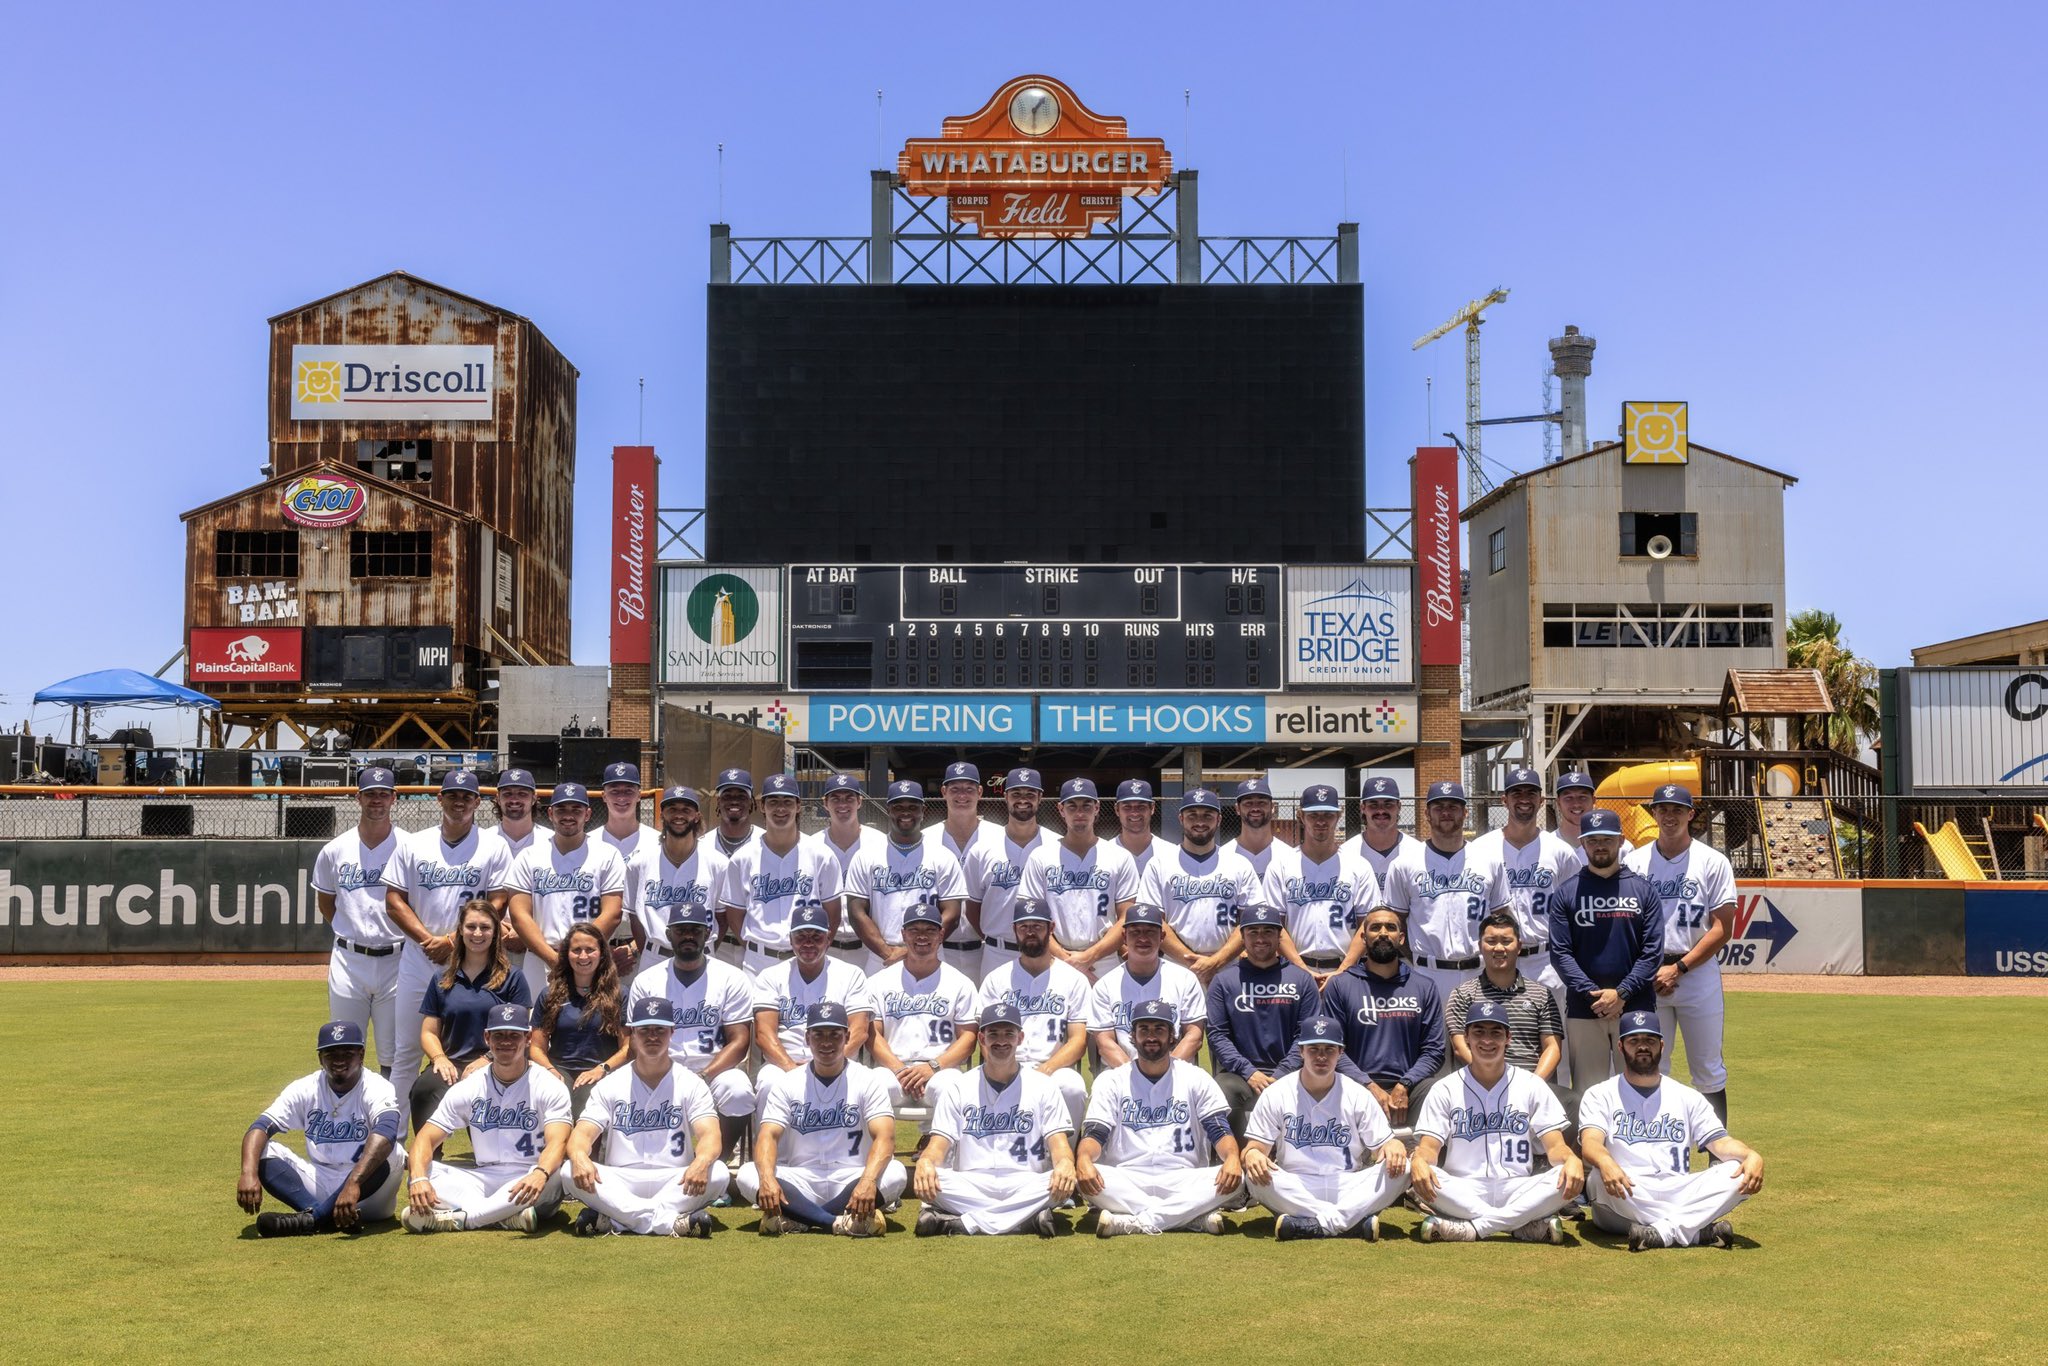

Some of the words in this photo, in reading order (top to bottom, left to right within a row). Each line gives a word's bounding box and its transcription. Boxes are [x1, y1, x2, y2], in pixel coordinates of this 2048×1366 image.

[921, 151, 1149, 174] WHATABURGER
[957, 196, 989, 205] CORPUS
[1080, 196, 1113, 205] CHRISTI
[999, 193, 1070, 224] Field
[344, 363, 486, 393] Driscoll
[618, 483, 645, 625] Budweiser
[1426, 484, 1454, 627] Budweiser
[807, 568, 825, 583] AT
[830, 568, 857, 583] BAT
[929, 568, 967, 583] BALL
[1025, 568, 1079, 583] STRIKE
[1134, 568, 1165, 583] OUT
[1231, 568, 1257, 584] H/E
[239, 599, 299, 623] BAM
[1304, 612, 1395, 637] TEXAS
[888, 624, 895, 636] 1
[908, 624, 916, 636] 2
[930, 624, 938, 636] 3
[954, 624, 962, 636] 4
[975, 624, 982, 636] 5
[996, 624, 1003, 636] 6
[1021, 624, 1029, 636] 7
[1042, 624, 1049, 636] 8
[1063, 624, 1070, 636] 9
[1083, 624, 1099, 636] 10
[1125, 624, 1160, 636] RUNS
[1186, 624, 1214, 636] HITS
[1240, 624, 1266, 636] ERR
[419, 647, 448, 667] MPH
[668, 650, 702, 668] SAN
[705, 649, 776, 669] JACINTO
[1299, 638, 1400, 662] BRIDGE
[1309, 666, 1348, 674] CREDIT
[1354, 666, 1391, 674] UNION
[829, 704, 1013, 732] POWERING
[1048, 705, 1117, 732] THE
[1128, 704, 1253, 733] HOOKS
[1275, 705, 1374, 734] reliant
[417, 859, 482, 891] Hooks
[533, 866, 595, 896] Hooks
[751, 870, 814, 904] Hooks
[872, 864, 937, 896] Hooks
[1046, 865, 1111, 894] Hooks
[1170, 873, 1237, 904] Hooks
[1415, 868, 1485, 899] Hooks
[1506, 862, 1553, 889] ooks
[645, 877, 708, 910] Hooks
[1097, 893, 1109, 916] 2
[1286, 876, 1351, 906] Hooks
[573, 896, 601, 919] 28
[1329, 904, 1357, 929] 24
[1578, 896, 1639, 924] HOOKS
[1678, 903, 1705, 928] 17
[884, 990, 950, 1019] Hooks
[1238, 982, 1298, 1010] HOOKS
[1360, 996, 1419, 1023] HOOKS
[673, 999, 720, 1027] ooks
[928, 1019, 953, 1043] 16
[305, 1108, 370, 1145] Hooks
[470, 1096, 539, 1132] Hooks
[613, 1100, 684, 1136] Hooks
[790, 1099, 859, 1135] Hooks
[962, 1103, 1034, 1139] Hooks
[1121, 1096, 1190, 1132] Hooks
[1451, 1104, 1530, 1142] Hooks
[1613, 1109, 1686, 1145] Hooks
[671, 1131, 685, 1157] 3
[847, 1130, 863, 1157] 7
[1173, 1128, 1195, 1153] 13
[1283, 1112, 1352, 1150] Hooks
[1009, 1137, 1045, 1162] 44
[1504, 1139, 1530, 1164] 19
